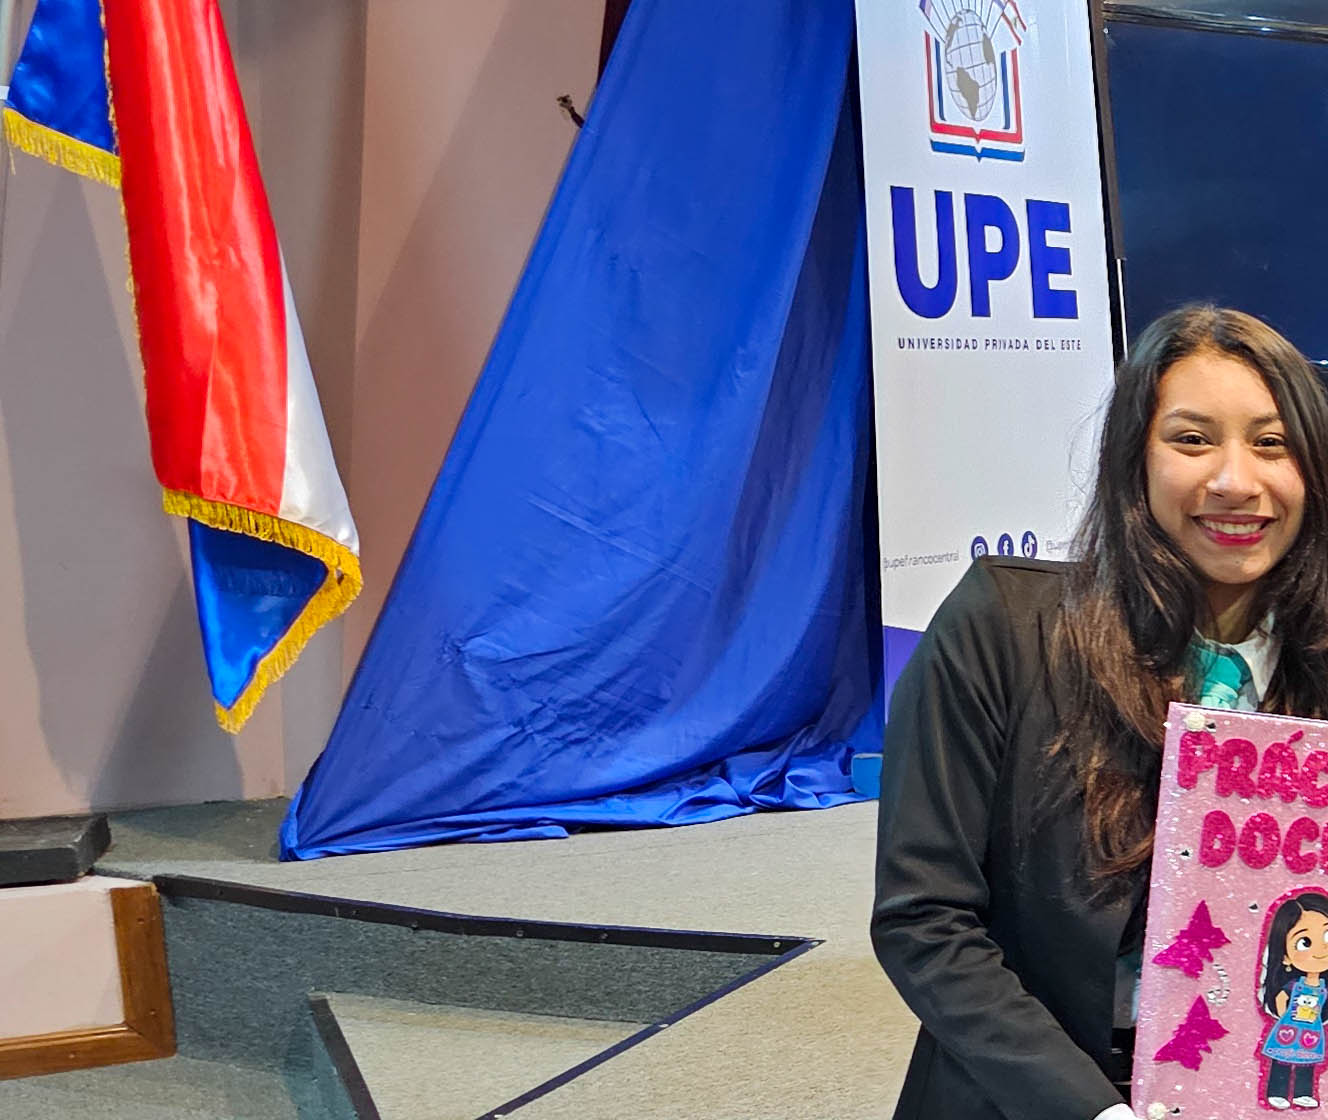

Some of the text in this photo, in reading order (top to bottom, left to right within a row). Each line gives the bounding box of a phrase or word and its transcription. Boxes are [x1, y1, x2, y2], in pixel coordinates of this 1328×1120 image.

[890, 185, 1079, 320] UPE
[898, 337, 1081, 351] UNIVERSIDAD PRIVADA DEL ESTE
